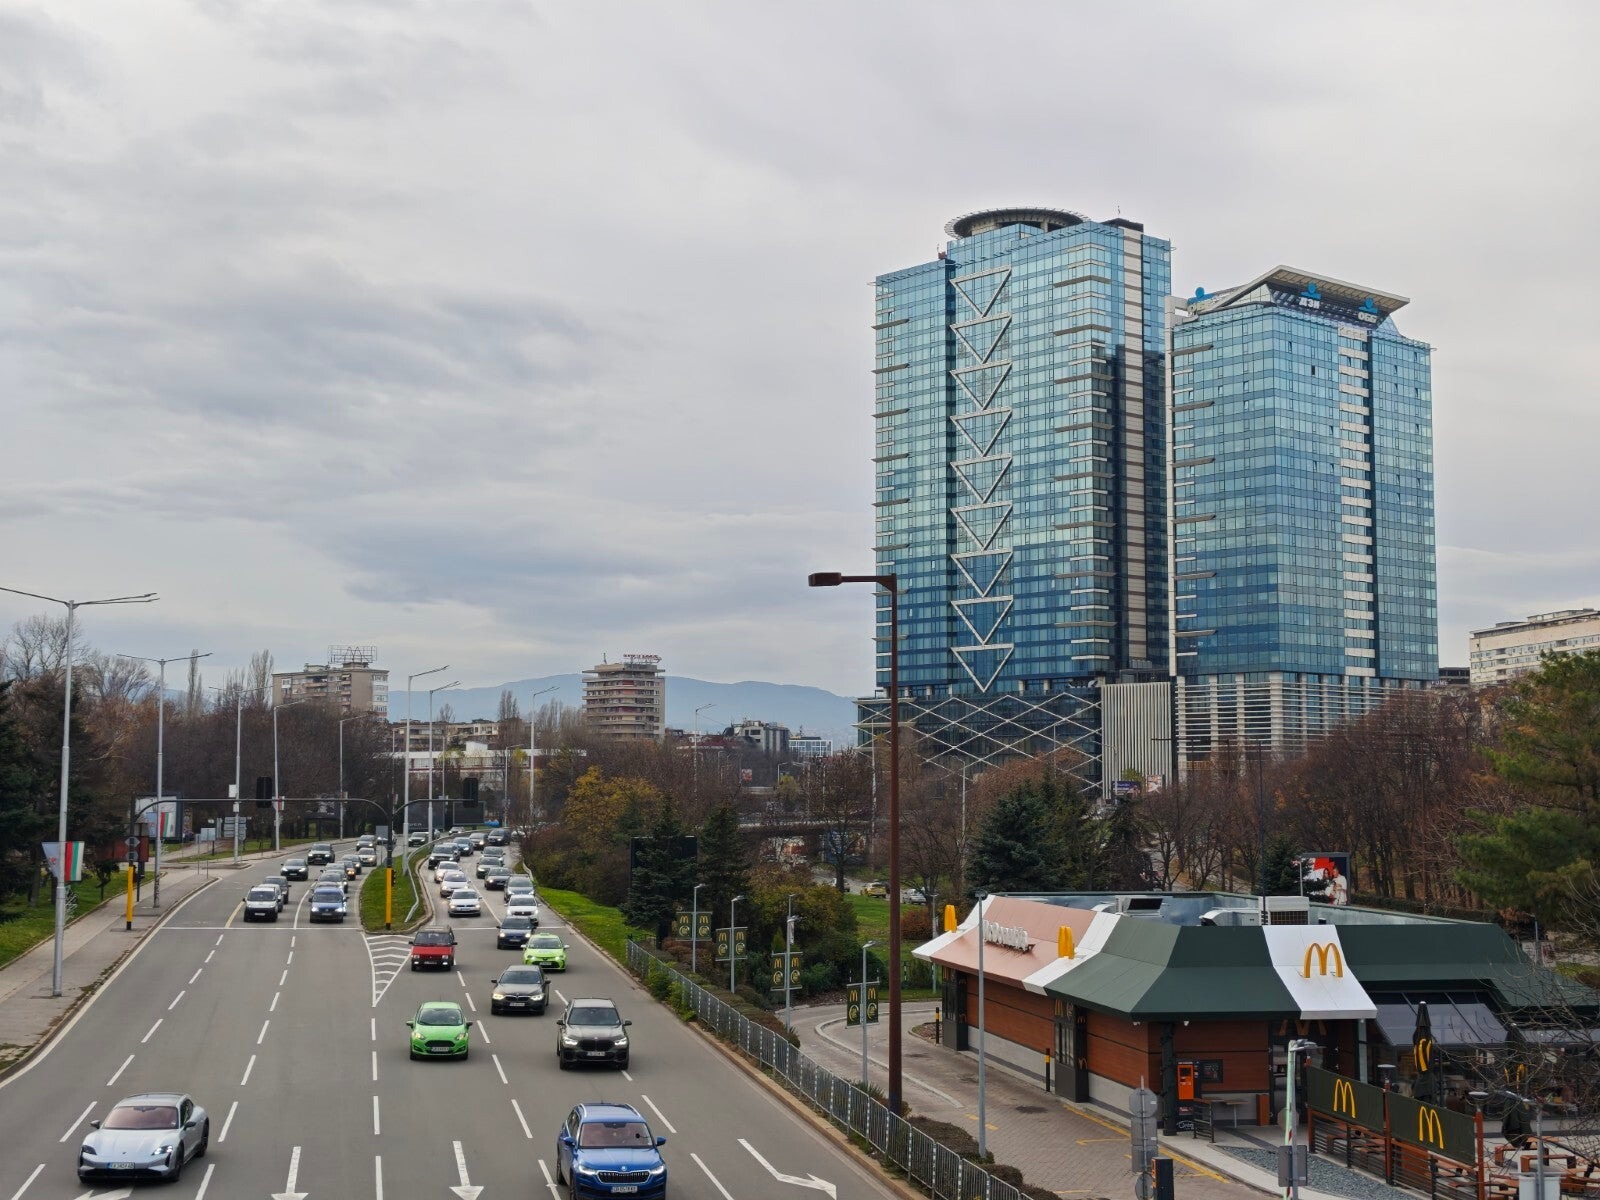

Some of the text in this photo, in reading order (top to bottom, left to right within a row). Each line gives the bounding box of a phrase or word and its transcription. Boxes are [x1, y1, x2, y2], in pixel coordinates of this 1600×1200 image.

[1299, 296, 1320, 309] ДЗИ
[1358, 311, 1377, 324] ОББ
[1304, 943, 1343, 978] M
